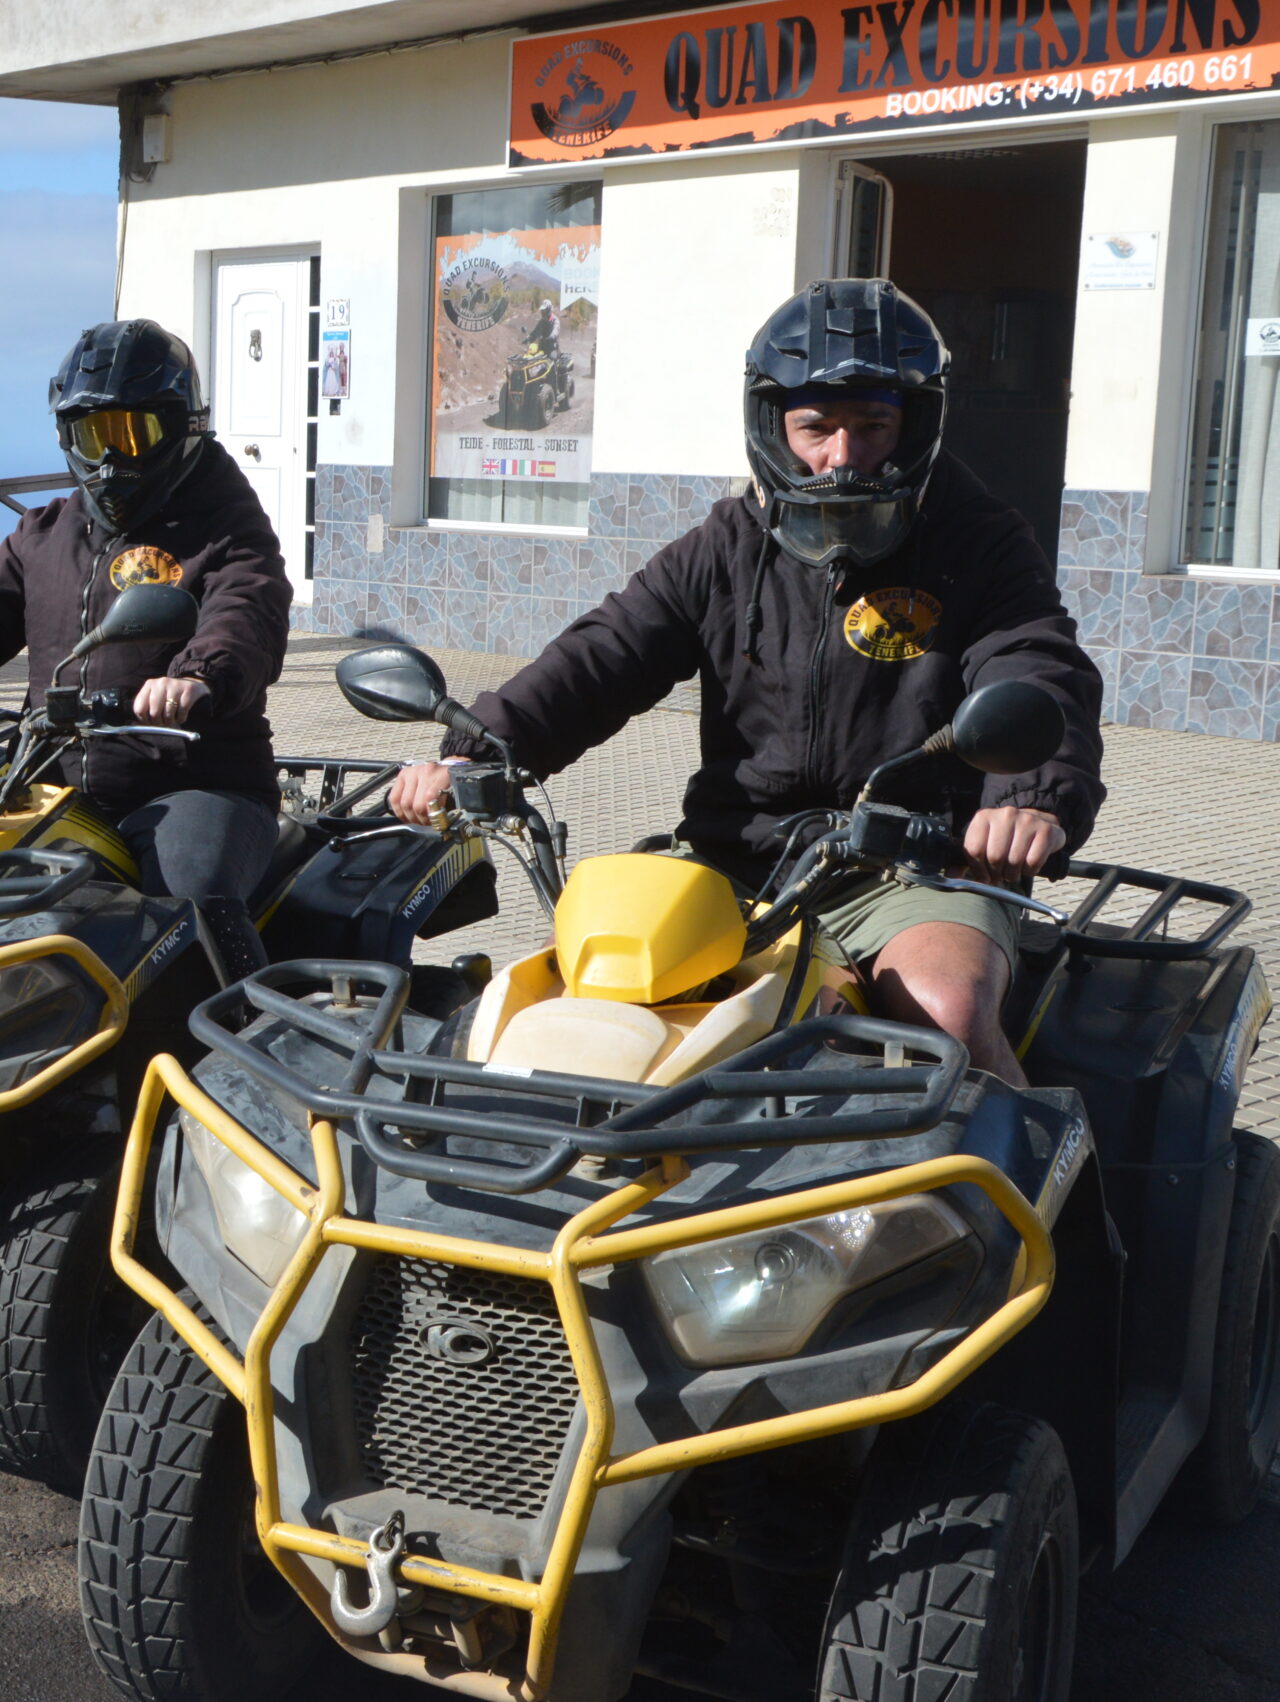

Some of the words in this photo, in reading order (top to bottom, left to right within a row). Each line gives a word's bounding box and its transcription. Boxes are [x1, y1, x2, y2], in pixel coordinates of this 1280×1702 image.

[535, 51, 563, 87] QUAD
[564, 40, 634, 76] EXCURSIONS
[664, 15, 817, 120] QUAD
[838, 0, 1261, 93] EXCURSIONS
[885, 80, 1013, 117] BOOKING:
[1020, 74, 1083, 108] (+34)
[1091, 66, 1136, 96] 671
[1145, 59, 1194, 90] 460
[1203, 52, 1253, 84] 661
[553, 121, 611, 145] TENERIFE
[443, 266, 461, 296] QUAD
[463, 257, 511, 292] EXCURSIONS
[331, 304, 345, 320] 19
[456, 317, 495, 331] TENERIFE
[459, 437, 483, 450] TEIDE
[492, 438, 535, 451] FORESTAL
[544, 439, 579, 452] SUNSET
[402, 884, 430, 919] KYMCO
[1053, 1117, 1085, 1186] KYMCO
